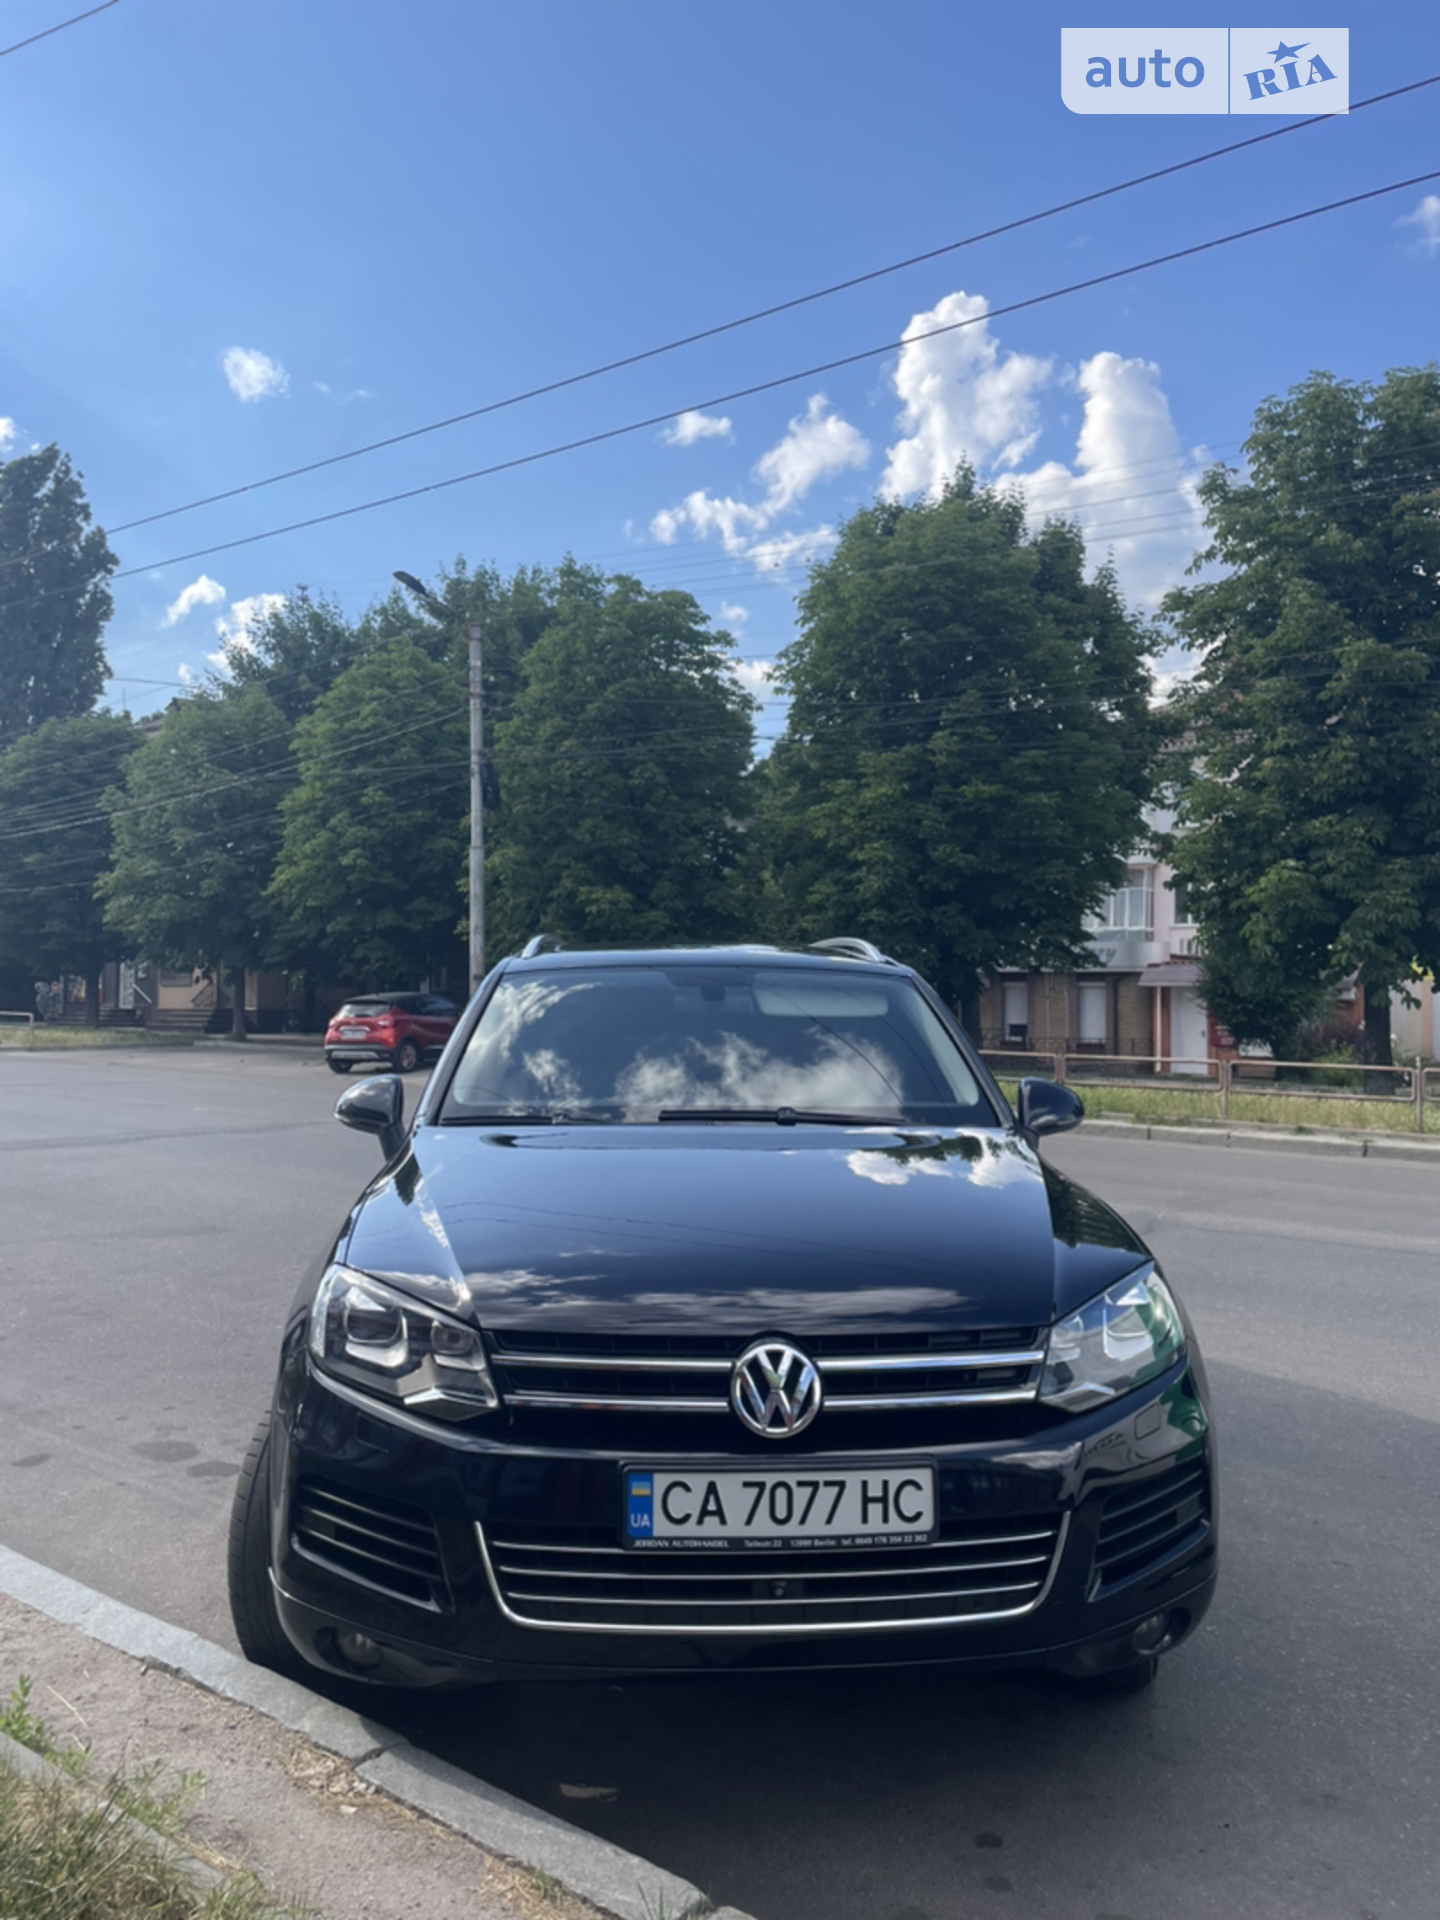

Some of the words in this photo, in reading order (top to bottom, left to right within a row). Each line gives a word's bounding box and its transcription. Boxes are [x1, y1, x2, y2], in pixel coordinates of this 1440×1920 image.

[661, 1480, 728, 1526] CA
[742, 1479, 847, 1527] 7077
[860, 1478, 925, 1525] HC
[630, 1513, 651, 1528] UA
